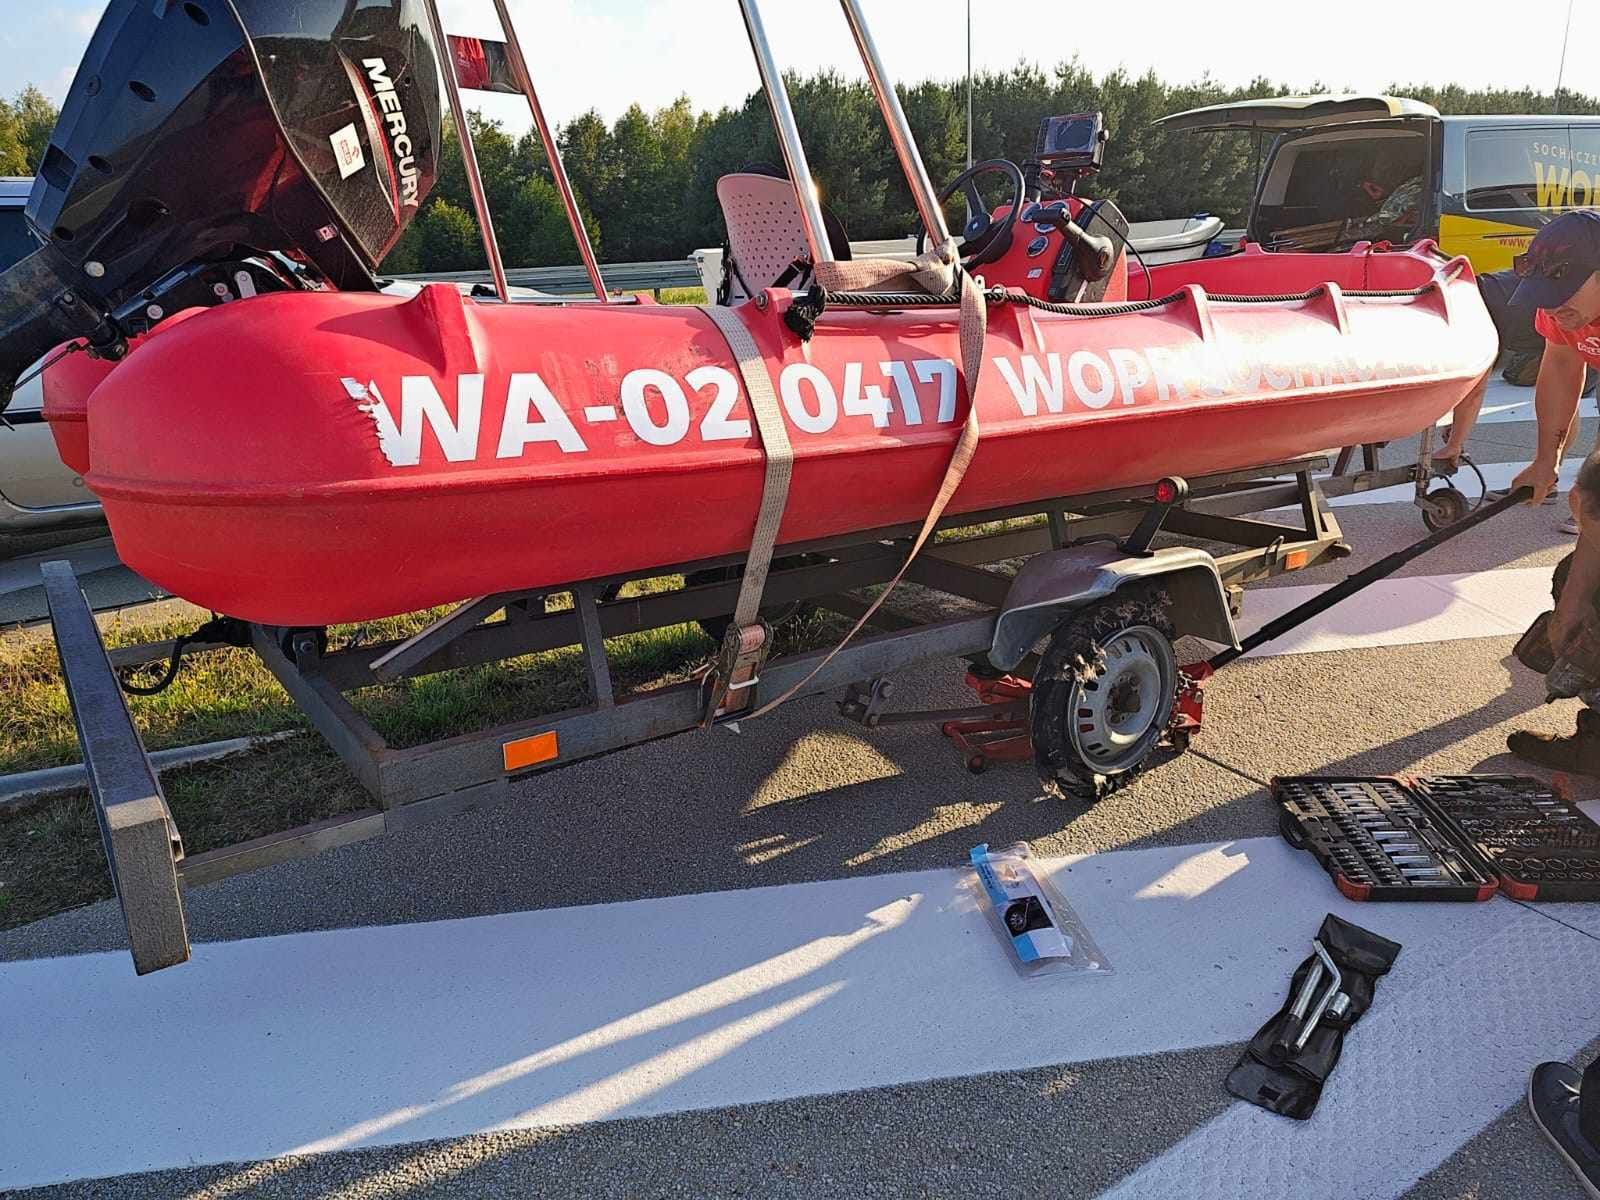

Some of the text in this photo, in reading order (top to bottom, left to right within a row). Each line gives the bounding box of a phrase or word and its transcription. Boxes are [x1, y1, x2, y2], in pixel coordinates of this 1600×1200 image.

[362, 57, 419, 207] MERCURY
[340, 366, 753, 467] WA-02
[779, 359, 958, 434] 0417
